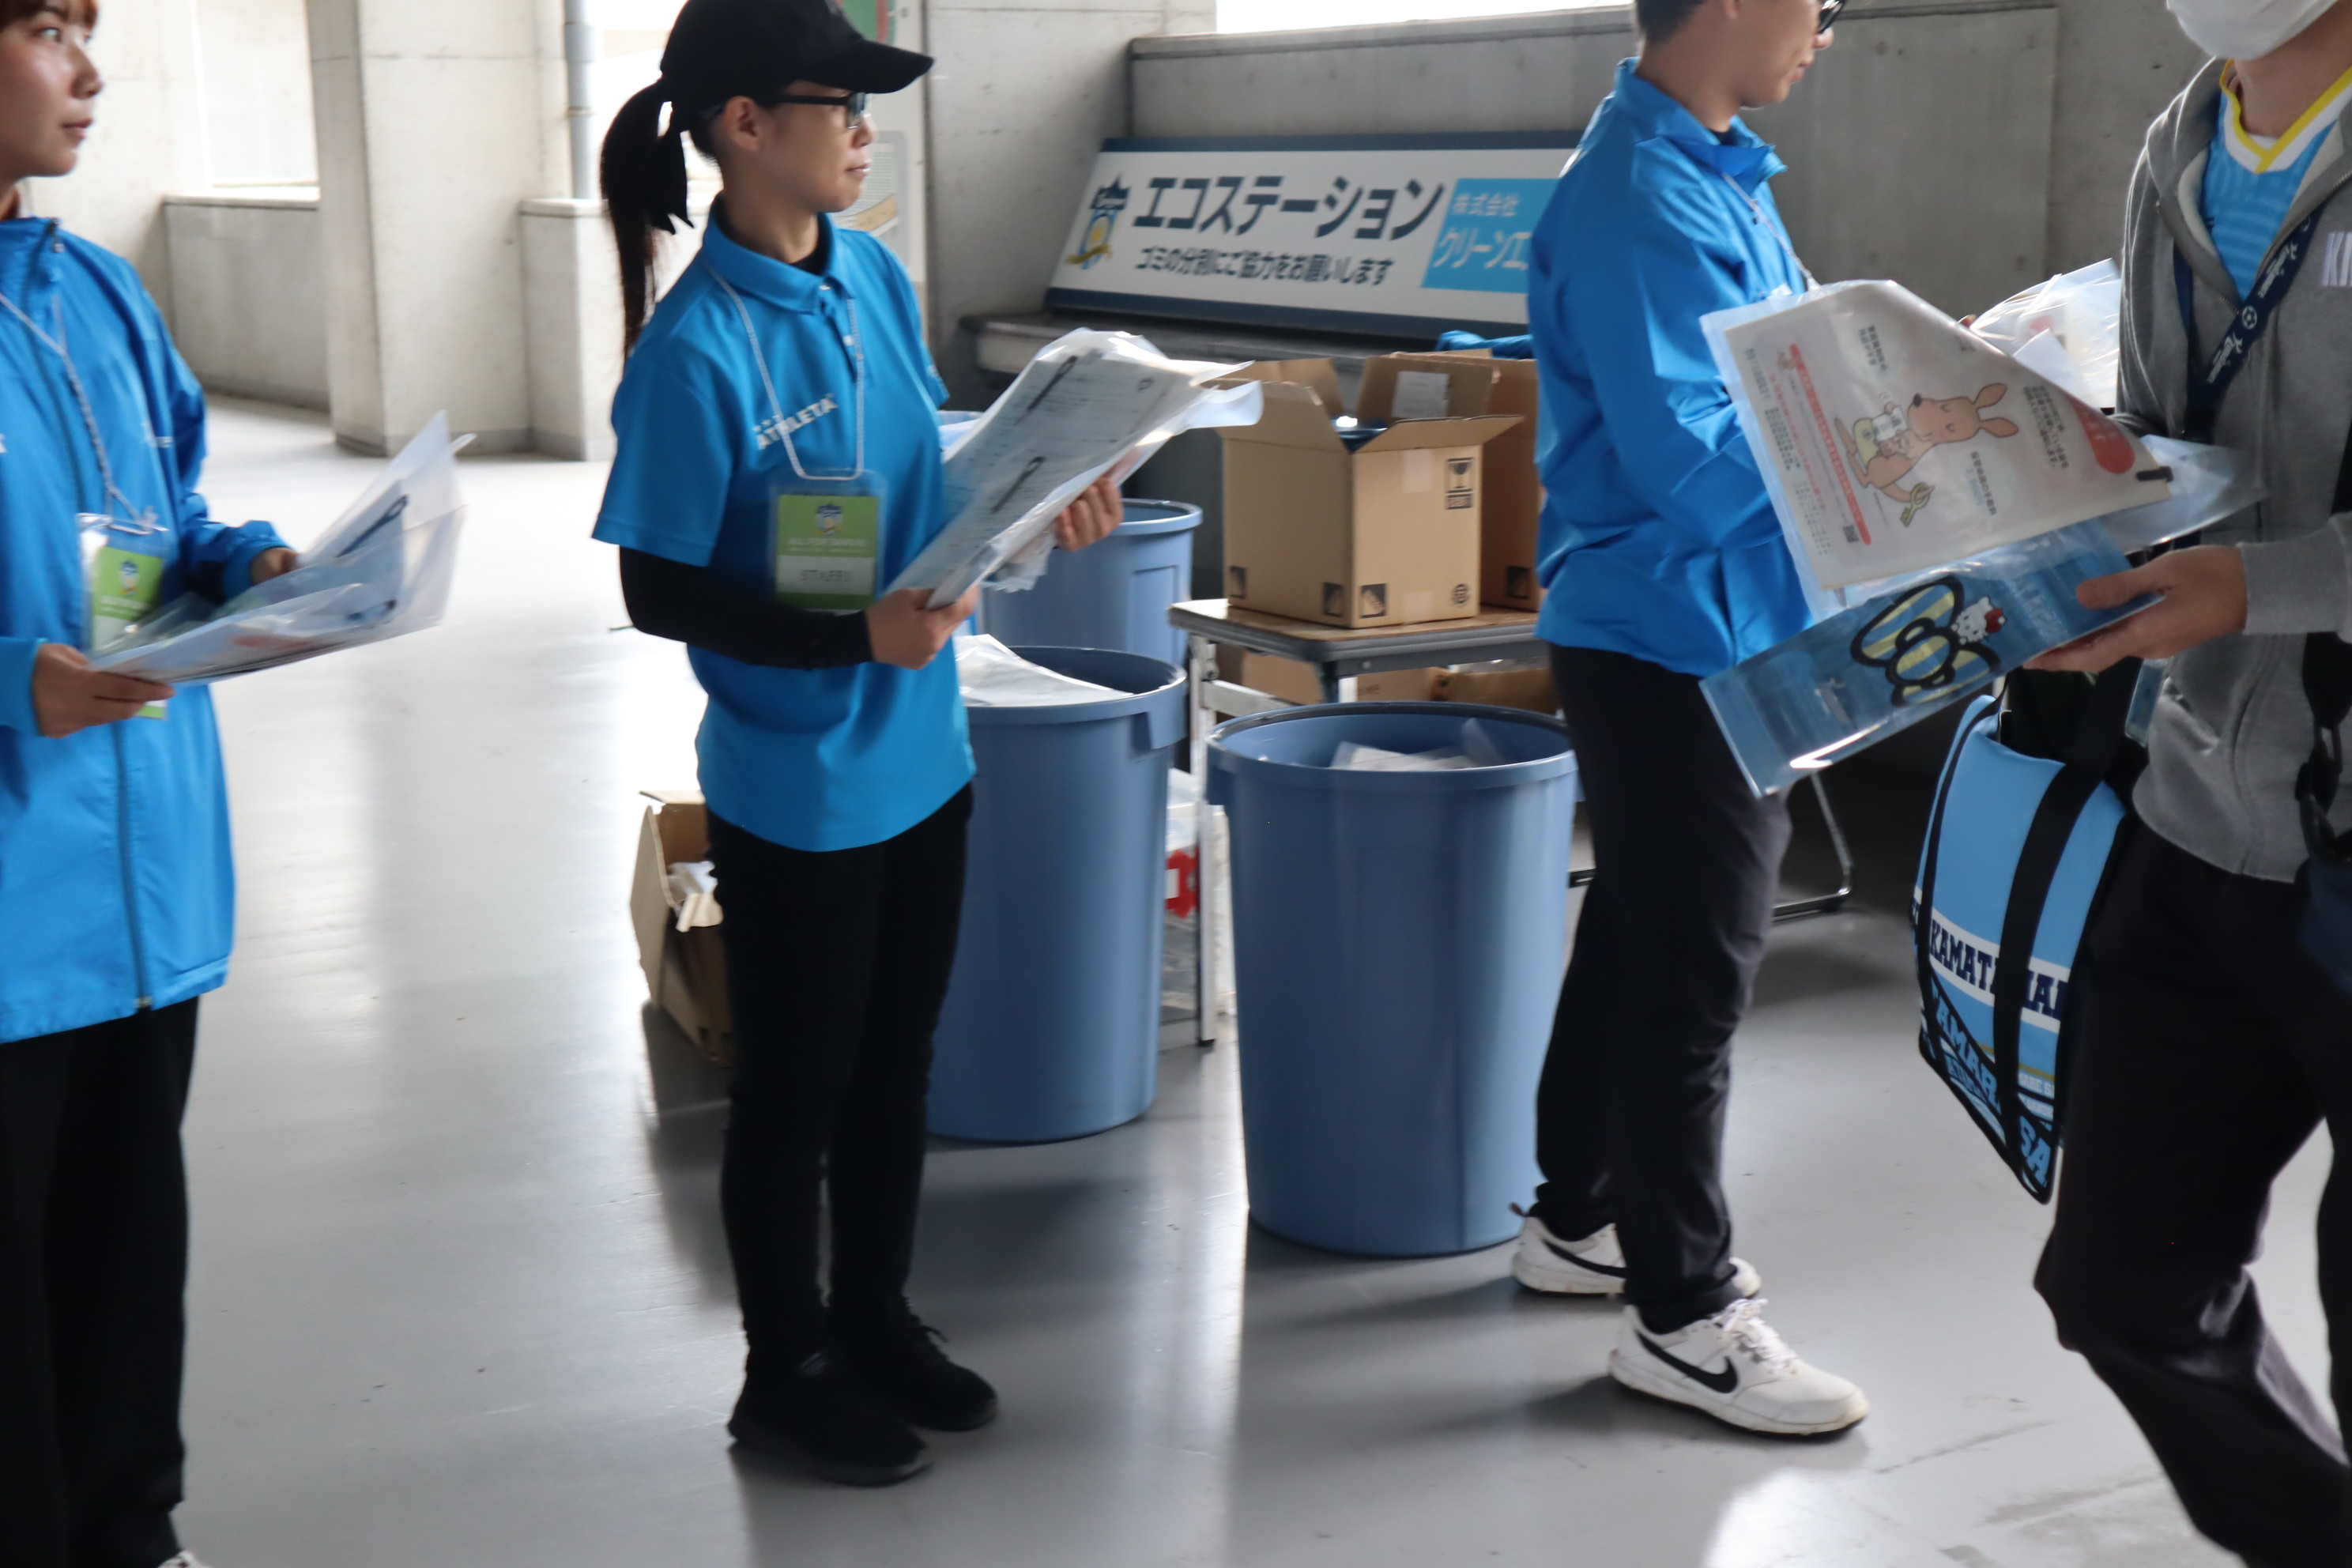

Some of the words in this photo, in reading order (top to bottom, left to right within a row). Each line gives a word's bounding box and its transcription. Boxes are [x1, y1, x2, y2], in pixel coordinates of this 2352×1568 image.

[1133, 175, 1446, 240] エコステーション
[1453, 193, 1520, 217] 株式会社
